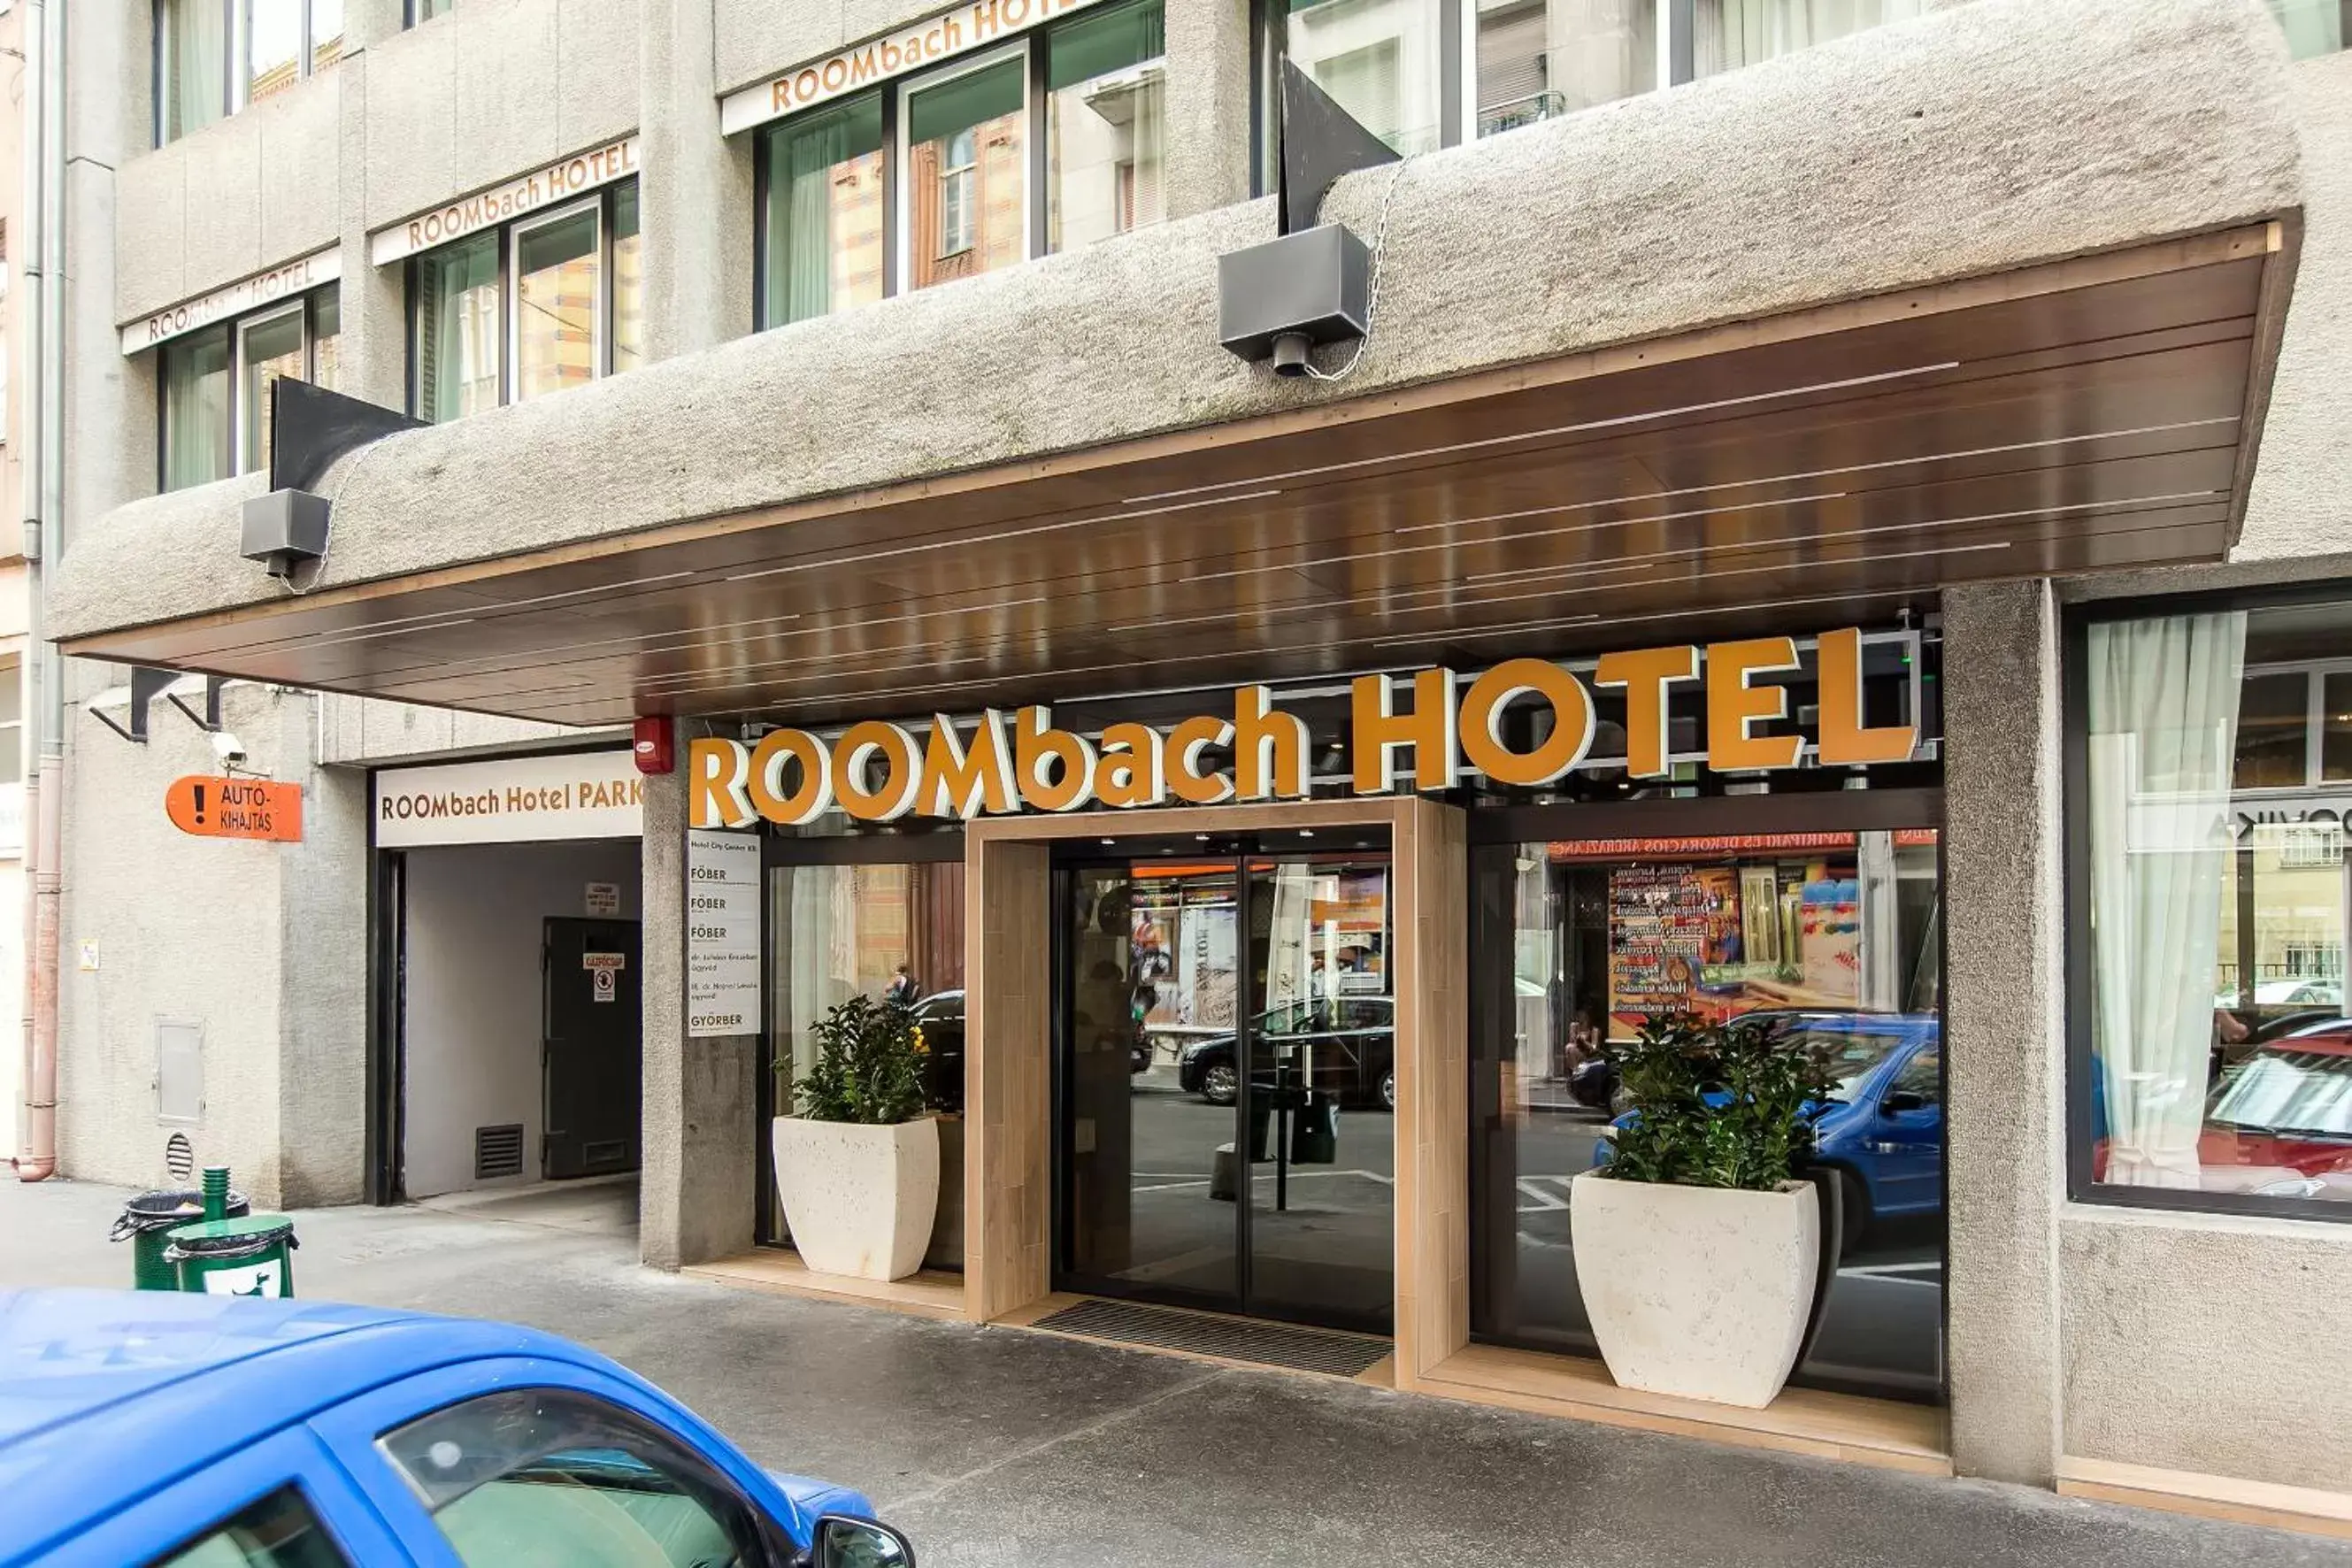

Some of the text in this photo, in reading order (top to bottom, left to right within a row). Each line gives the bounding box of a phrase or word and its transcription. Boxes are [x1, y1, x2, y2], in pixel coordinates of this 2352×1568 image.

[772, 16, 962, 113] ROOMbach
[408, 142, 634, 250] ROOMbach HOTEL
[251, 260, 314, 303] HOTEL
[689, 626, 1920, 829] ROOMbach HOTEL
[220, 783, 271, 807] AUTÓ-
[381, 788, 500, 820] ROOMbach
[506, 783, 570, 813] Hotel
[220, 808, 273, 833] KIHAJTÁS
